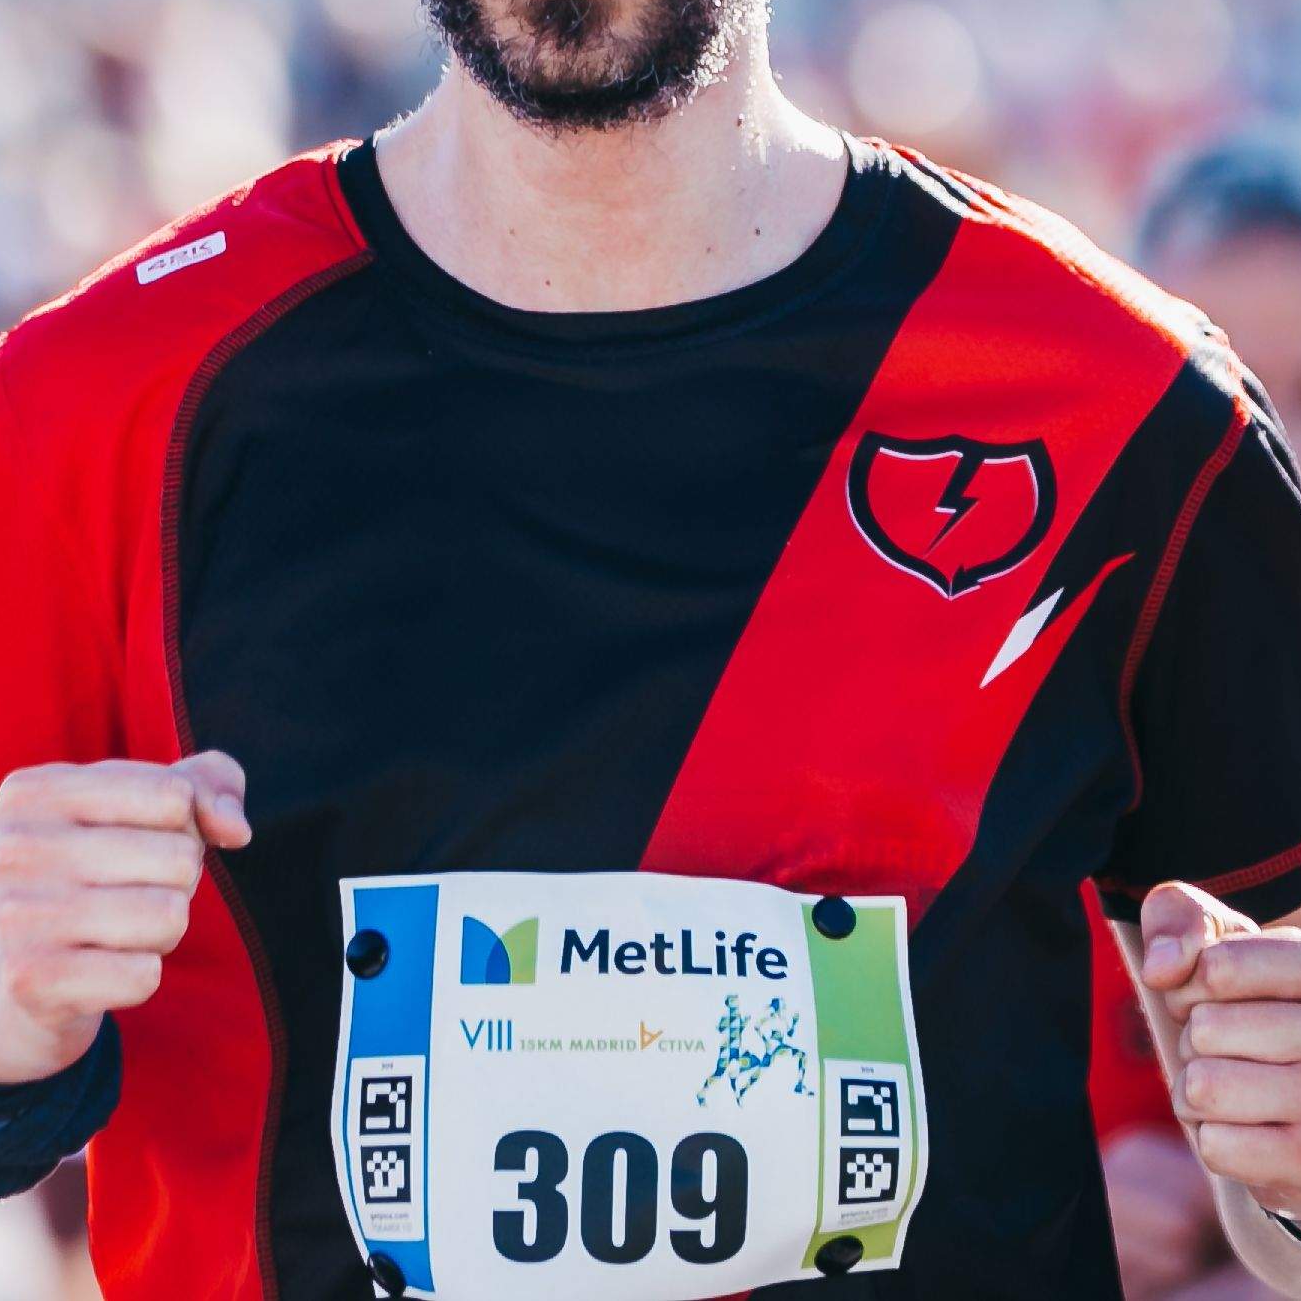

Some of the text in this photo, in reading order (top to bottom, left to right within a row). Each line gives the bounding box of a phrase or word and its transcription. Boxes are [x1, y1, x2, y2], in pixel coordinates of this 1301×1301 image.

[560, 928, 789, 981] MetLife
[460, 1018, 513, 1052] VIII
[520, 1038, 563, 1052] 15KM
[492, 1129, 750, 1265] 309
